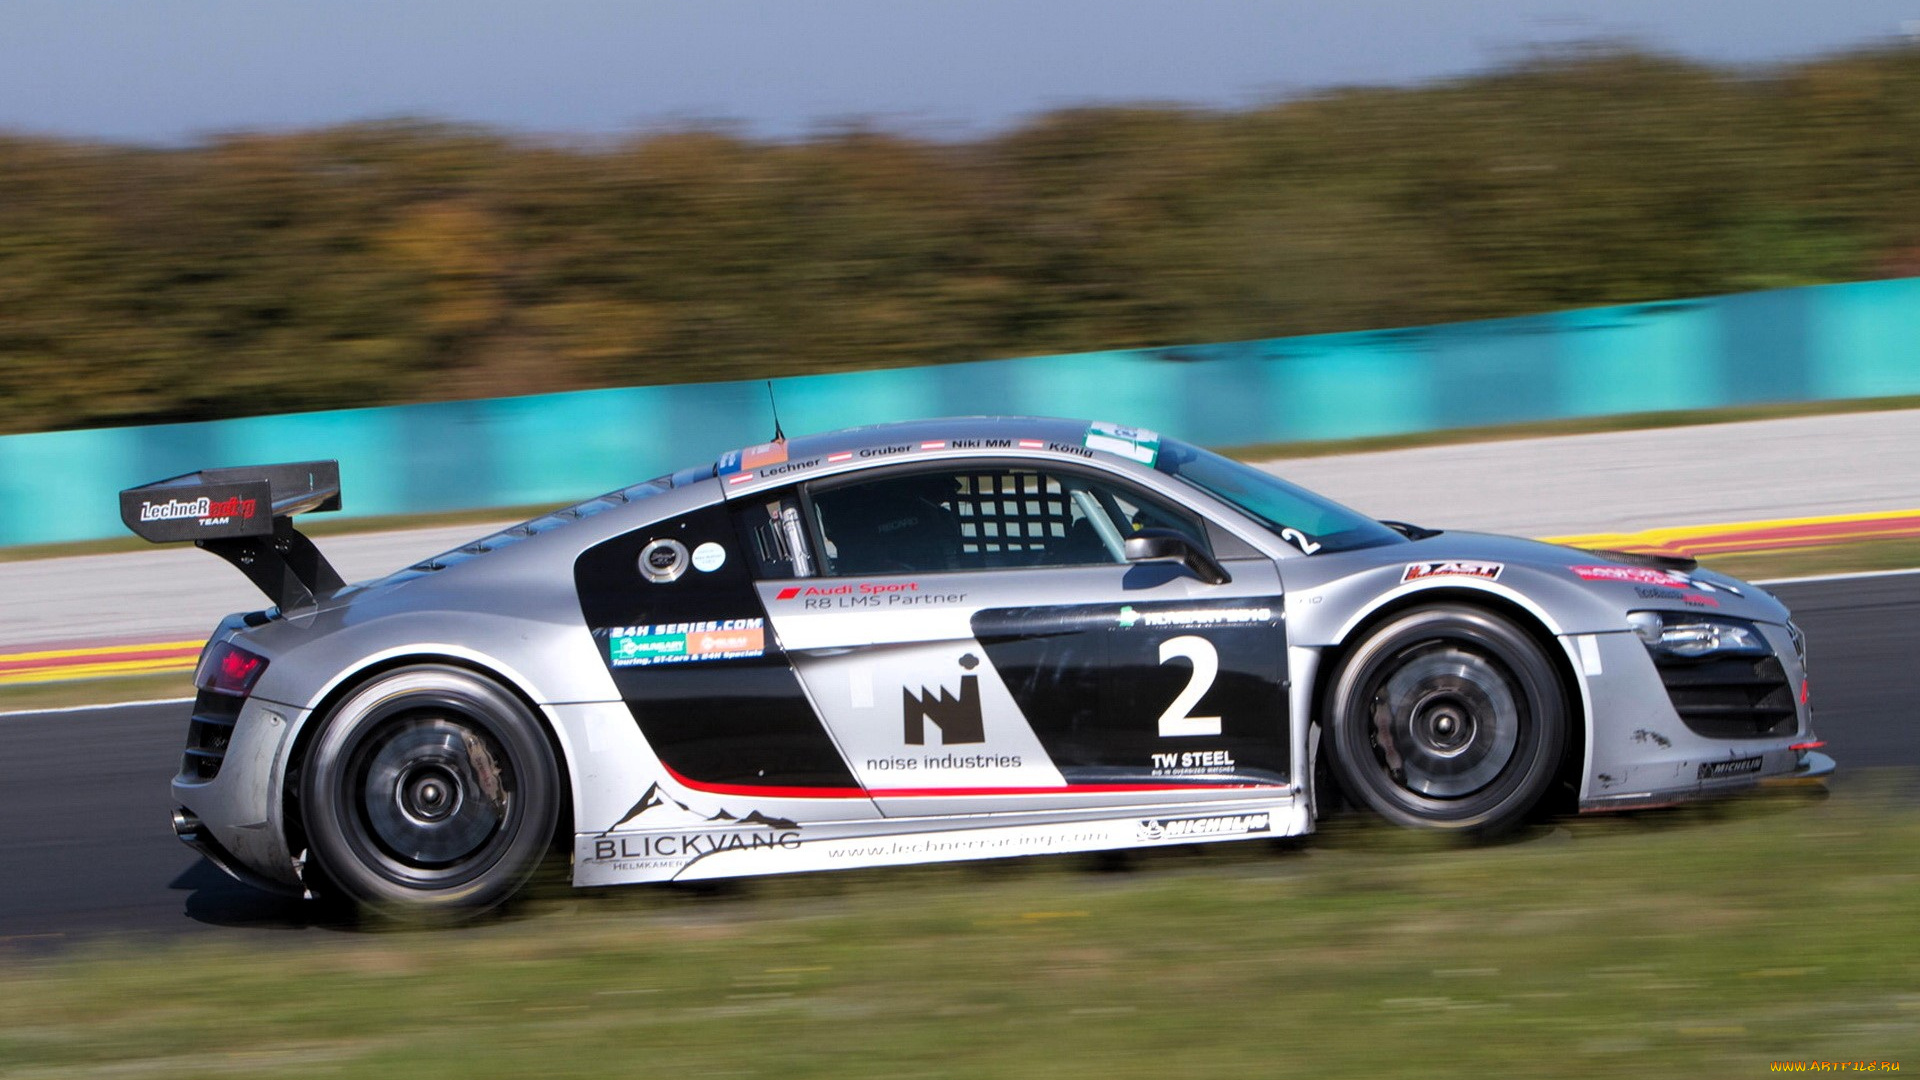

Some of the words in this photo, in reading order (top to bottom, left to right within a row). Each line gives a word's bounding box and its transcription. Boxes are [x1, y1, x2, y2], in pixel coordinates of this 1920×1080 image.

[859, 443, 913, 458] Gruber
[952, 439, 981, 449] Niki
[985, 439, 1011, 448] MM
[1049, 442, 1094, 458] König
[760, 458, 820, 478] Lechner
[199, 516, 229, 526] TEAM
[1281, 527, 1322, 556] 2
[804, 586, 852, 596] Audi
[859, 582, 920, 596] Sport
[805, 598, 833, 611] R8
[839, 597, 881, 608] LMS
[888, 593, 967, 606] Partner
[612, 625, 649, 638] 24H
[654, 619, 763, 635] SERIES.COM
[612, 657, 652, 667] Touring,
[1157, 634, 1223, 738] 2
[867, 757, 917, 771] noise
[924, 752, 1022, 769] industries
[1151, 752, 1179, 769] TW
[1181, 750, 1235, 767] STEEL
[1714, 758, 1762, 772] MICHELIN
[1167, 815, 1268, 835] MICHELIN
[594, 832, 803, 861] BLICKVANG
